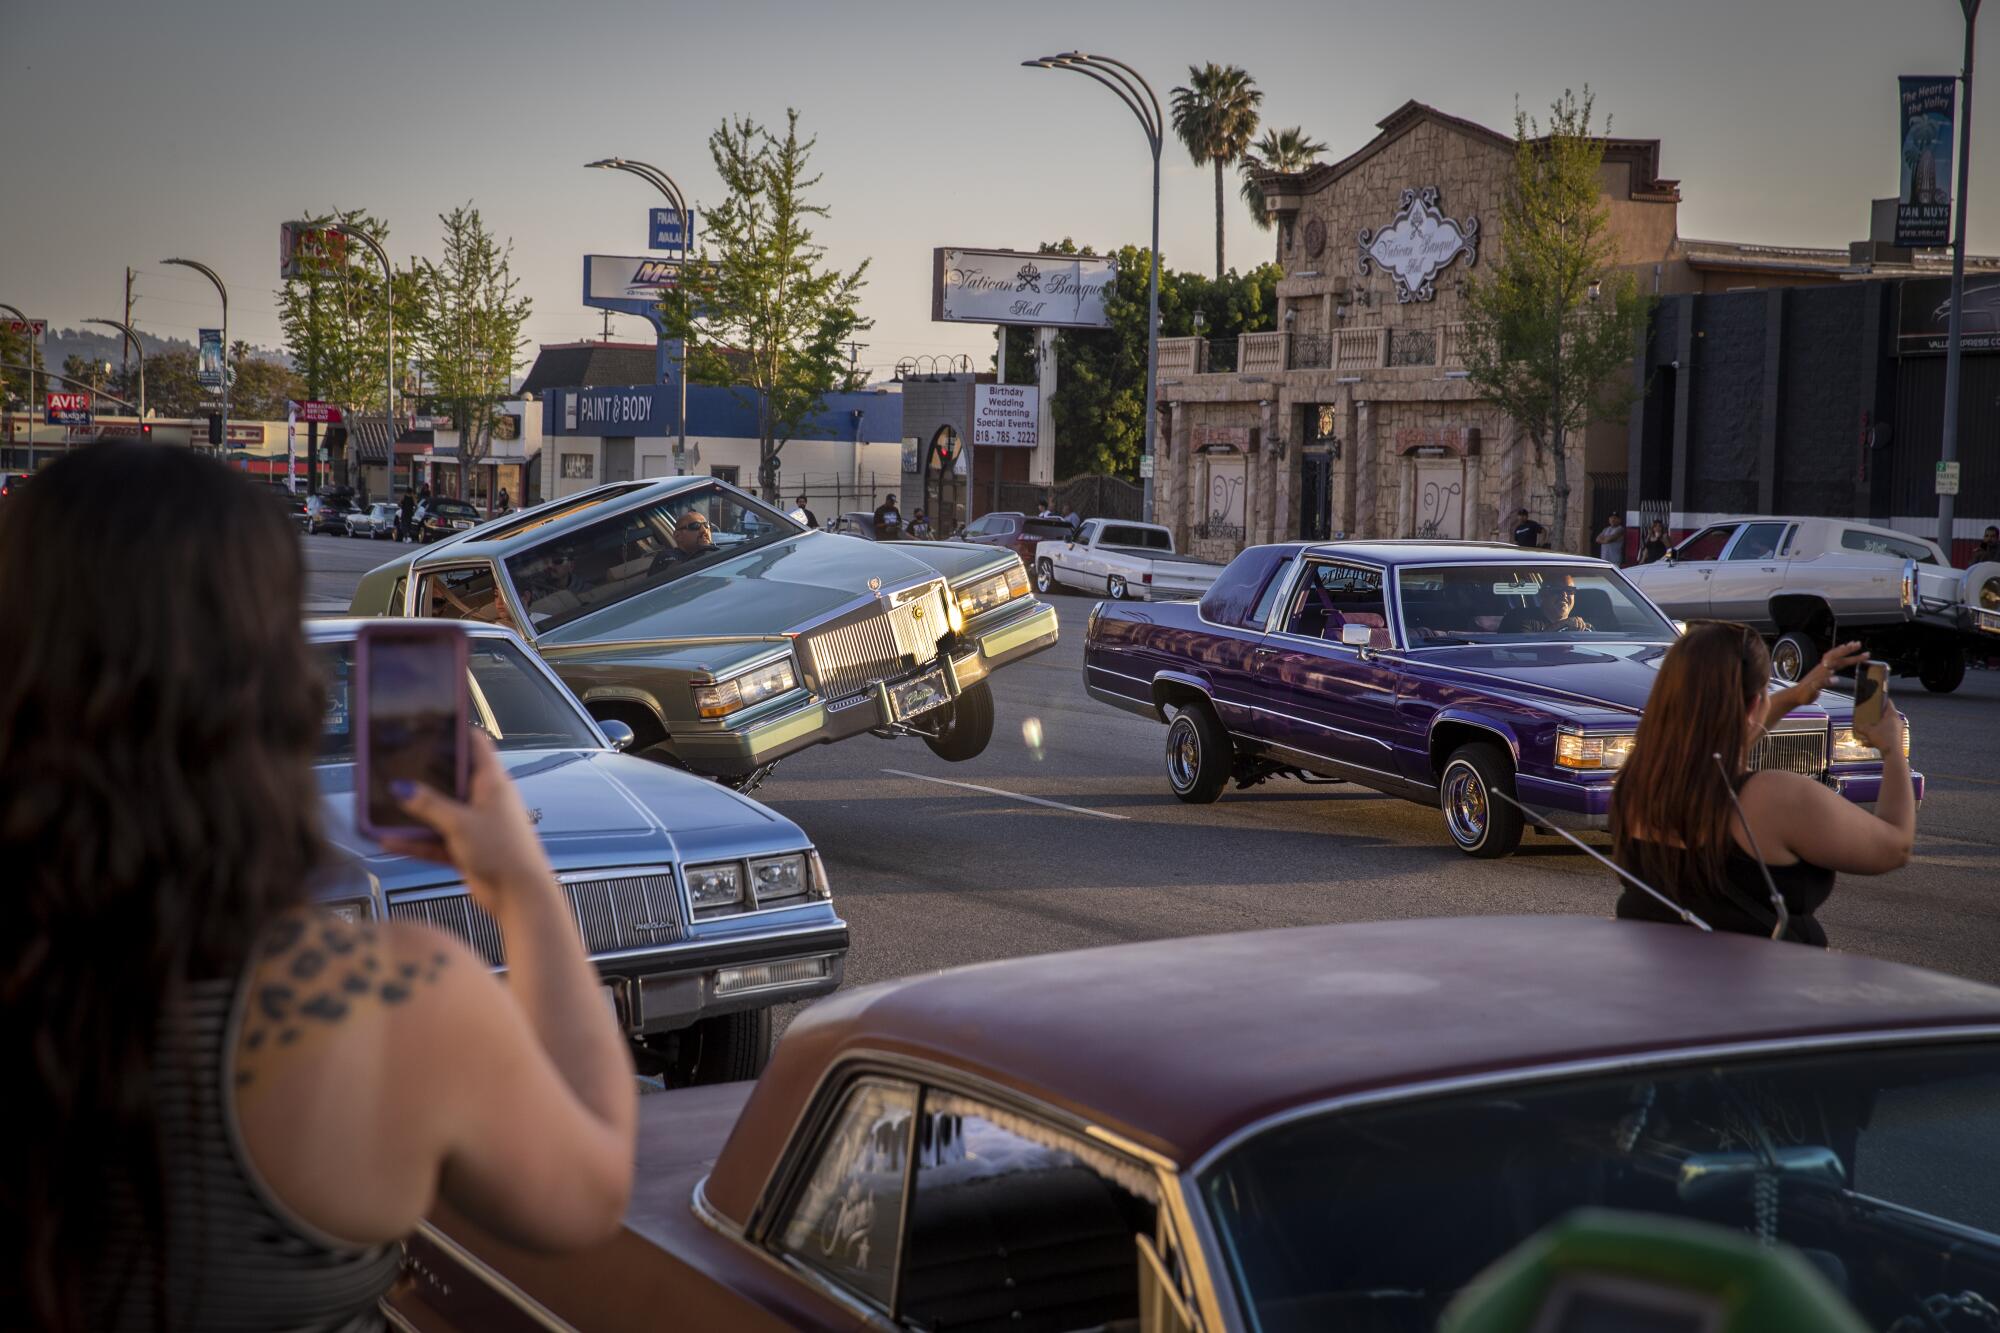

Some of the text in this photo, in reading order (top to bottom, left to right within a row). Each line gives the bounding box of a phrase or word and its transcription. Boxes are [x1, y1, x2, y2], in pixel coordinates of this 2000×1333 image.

[1919, 84, 1942, 97] Heart
[1924, 96, 1949, 109] Valley
[1900, 206, 1949, 217] VAN NUYS
[657, 231, 690, 244] AVAILAE
[950, 268, 1102, 299] Vatican Banque
[1009, 300, 1048, 317] Hall
[1928, 339, 1950, 349] VALLE
[989, 386, 1024, 397] Birthday
[50, 394, 85, 409] AVIS
[988, 397, 1025, 408] Wedding
[581, 394, 653, 424] PAINT & BODY
[982, 407, 1030, 418] Christening
[976, 417, 1035, 429] Special Events
[975, 430, 989, 442] 818
[996, 431, 1010, 443] 785
[1017, 431, 1036, 444] 2222
